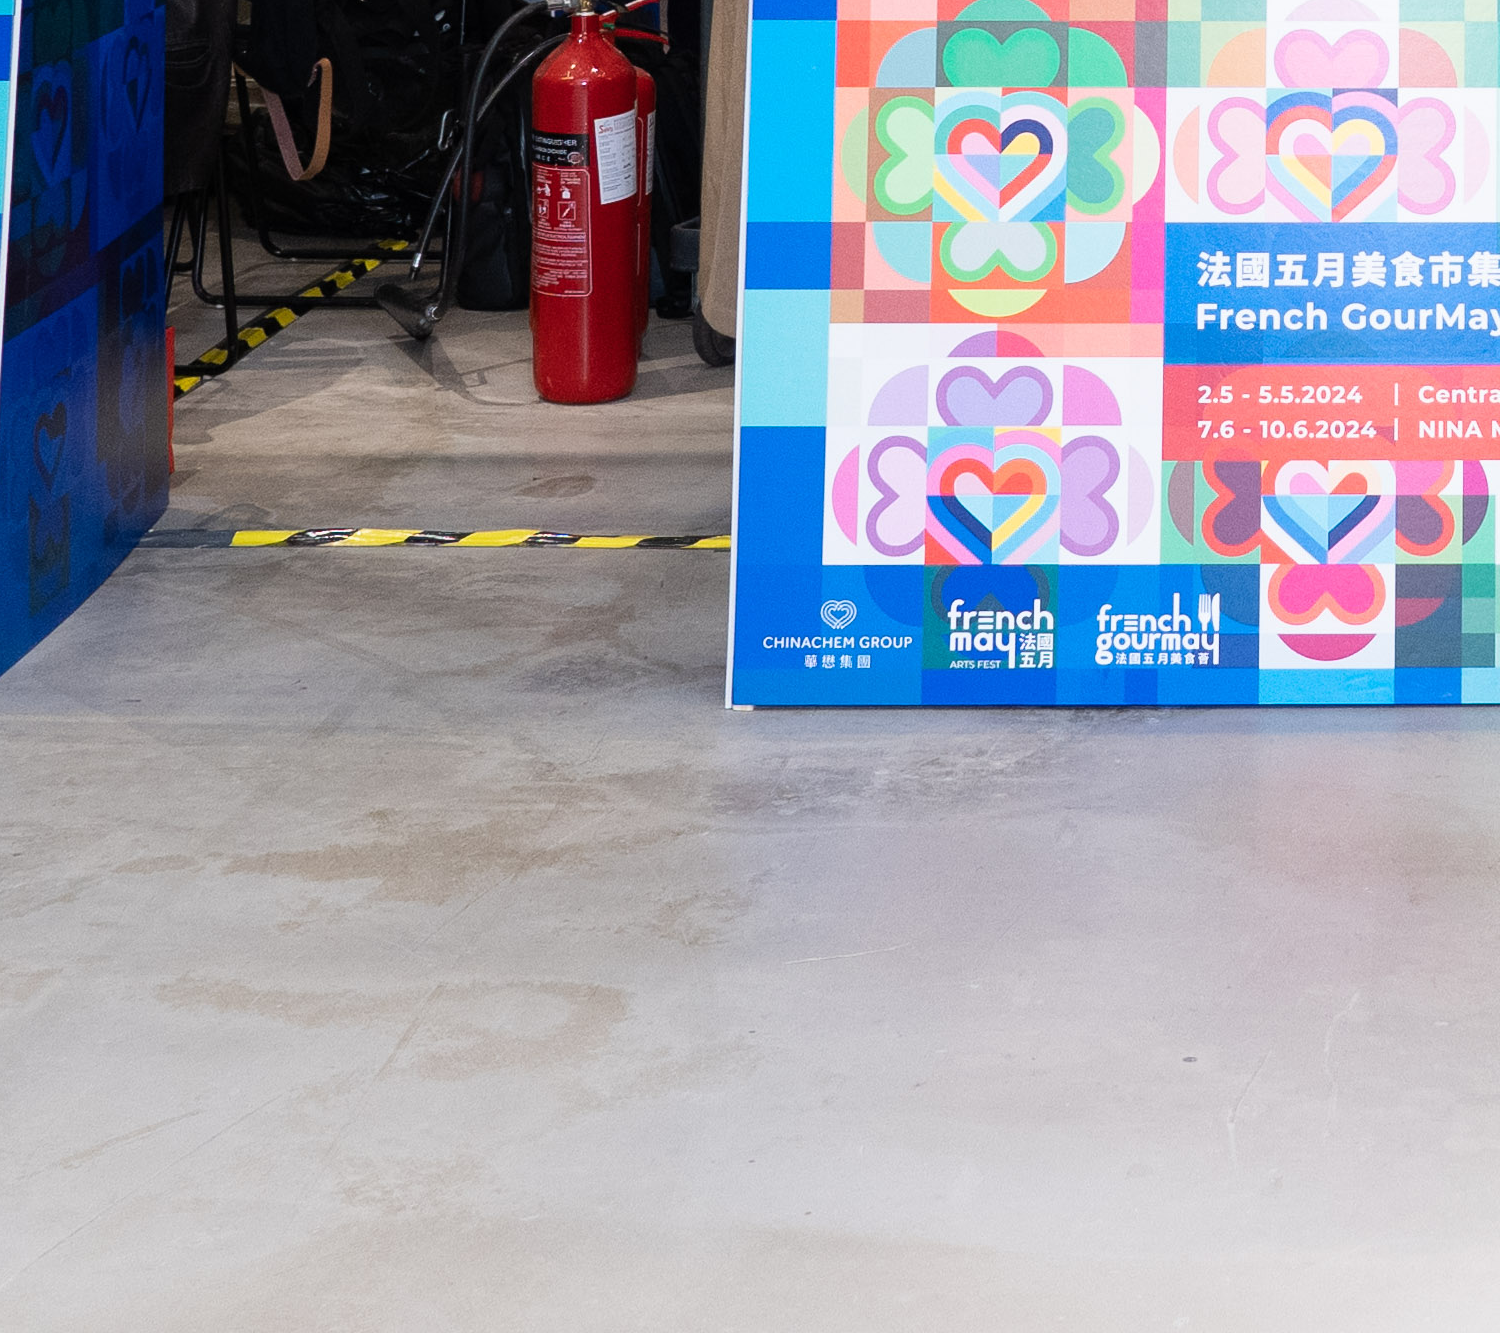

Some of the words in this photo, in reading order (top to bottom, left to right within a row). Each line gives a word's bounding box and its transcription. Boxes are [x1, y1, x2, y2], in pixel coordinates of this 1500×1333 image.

[1196, 302, 1328, 330] French
[1197, 384, 1234, 404] 2.5
[1257, 384, 1363, 404] 5.5.2024
[1197, 419, 1234, 439] 7.6
[1259, 419, 1377, 439] 10.6.2024
[1418, 419, 1483, 439] NINA
[947, 598, 1054, 631] french
[1096, 592, 1191, 631] french
[762, 635, 856, 650] CHINACHEM
[859, 635, 913, 650] GROUP
[948, 631, 1017, 669] may
[1018, 632, 1053, 650] 法國
[1095, 630, 1220, 666] gourmay
[949, 659, 976, 669] ARTS
[977, 659, 1002, 669] FEST
[1018, 651, 1054, 669] 五月
